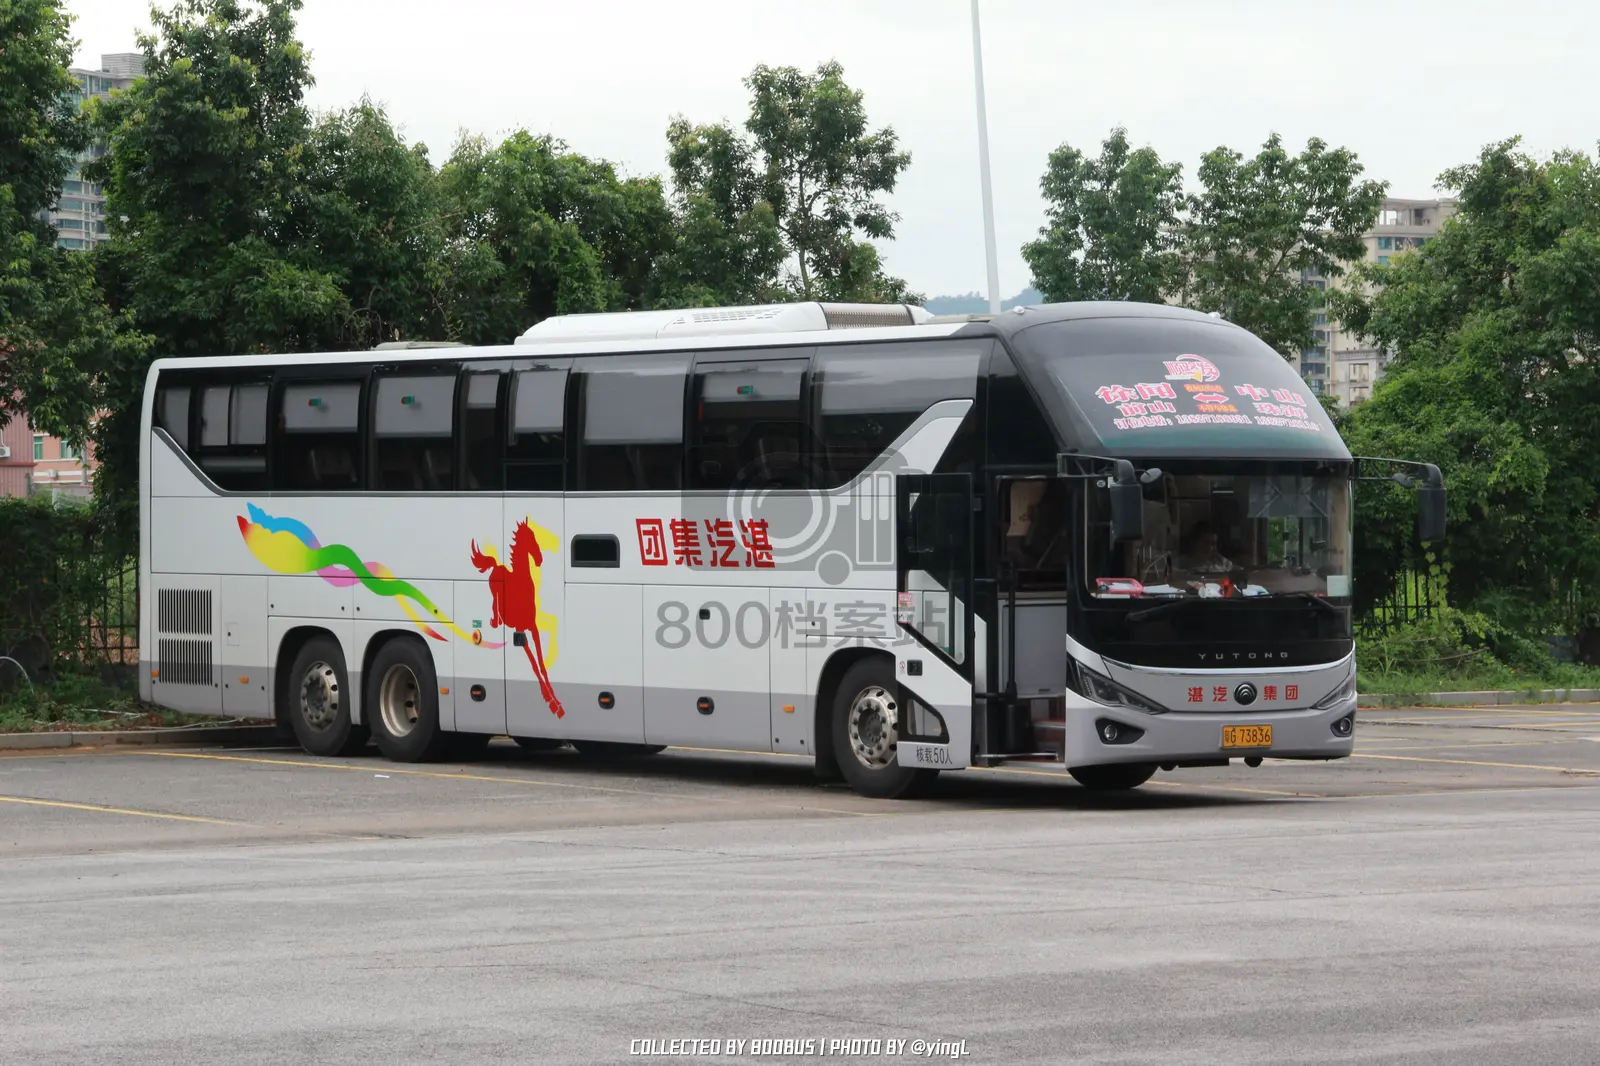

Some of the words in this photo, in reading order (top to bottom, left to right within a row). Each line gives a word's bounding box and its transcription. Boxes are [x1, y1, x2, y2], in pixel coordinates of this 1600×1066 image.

[1095, 382, 1177, 404] 徐闻
[1234, 383, 1307, 407] 中山
[1116, 400, 1177, 417] 前山
[1198, 652, 1289, 660] YUTONG
[916, 746, 953, 765] 核载50人
